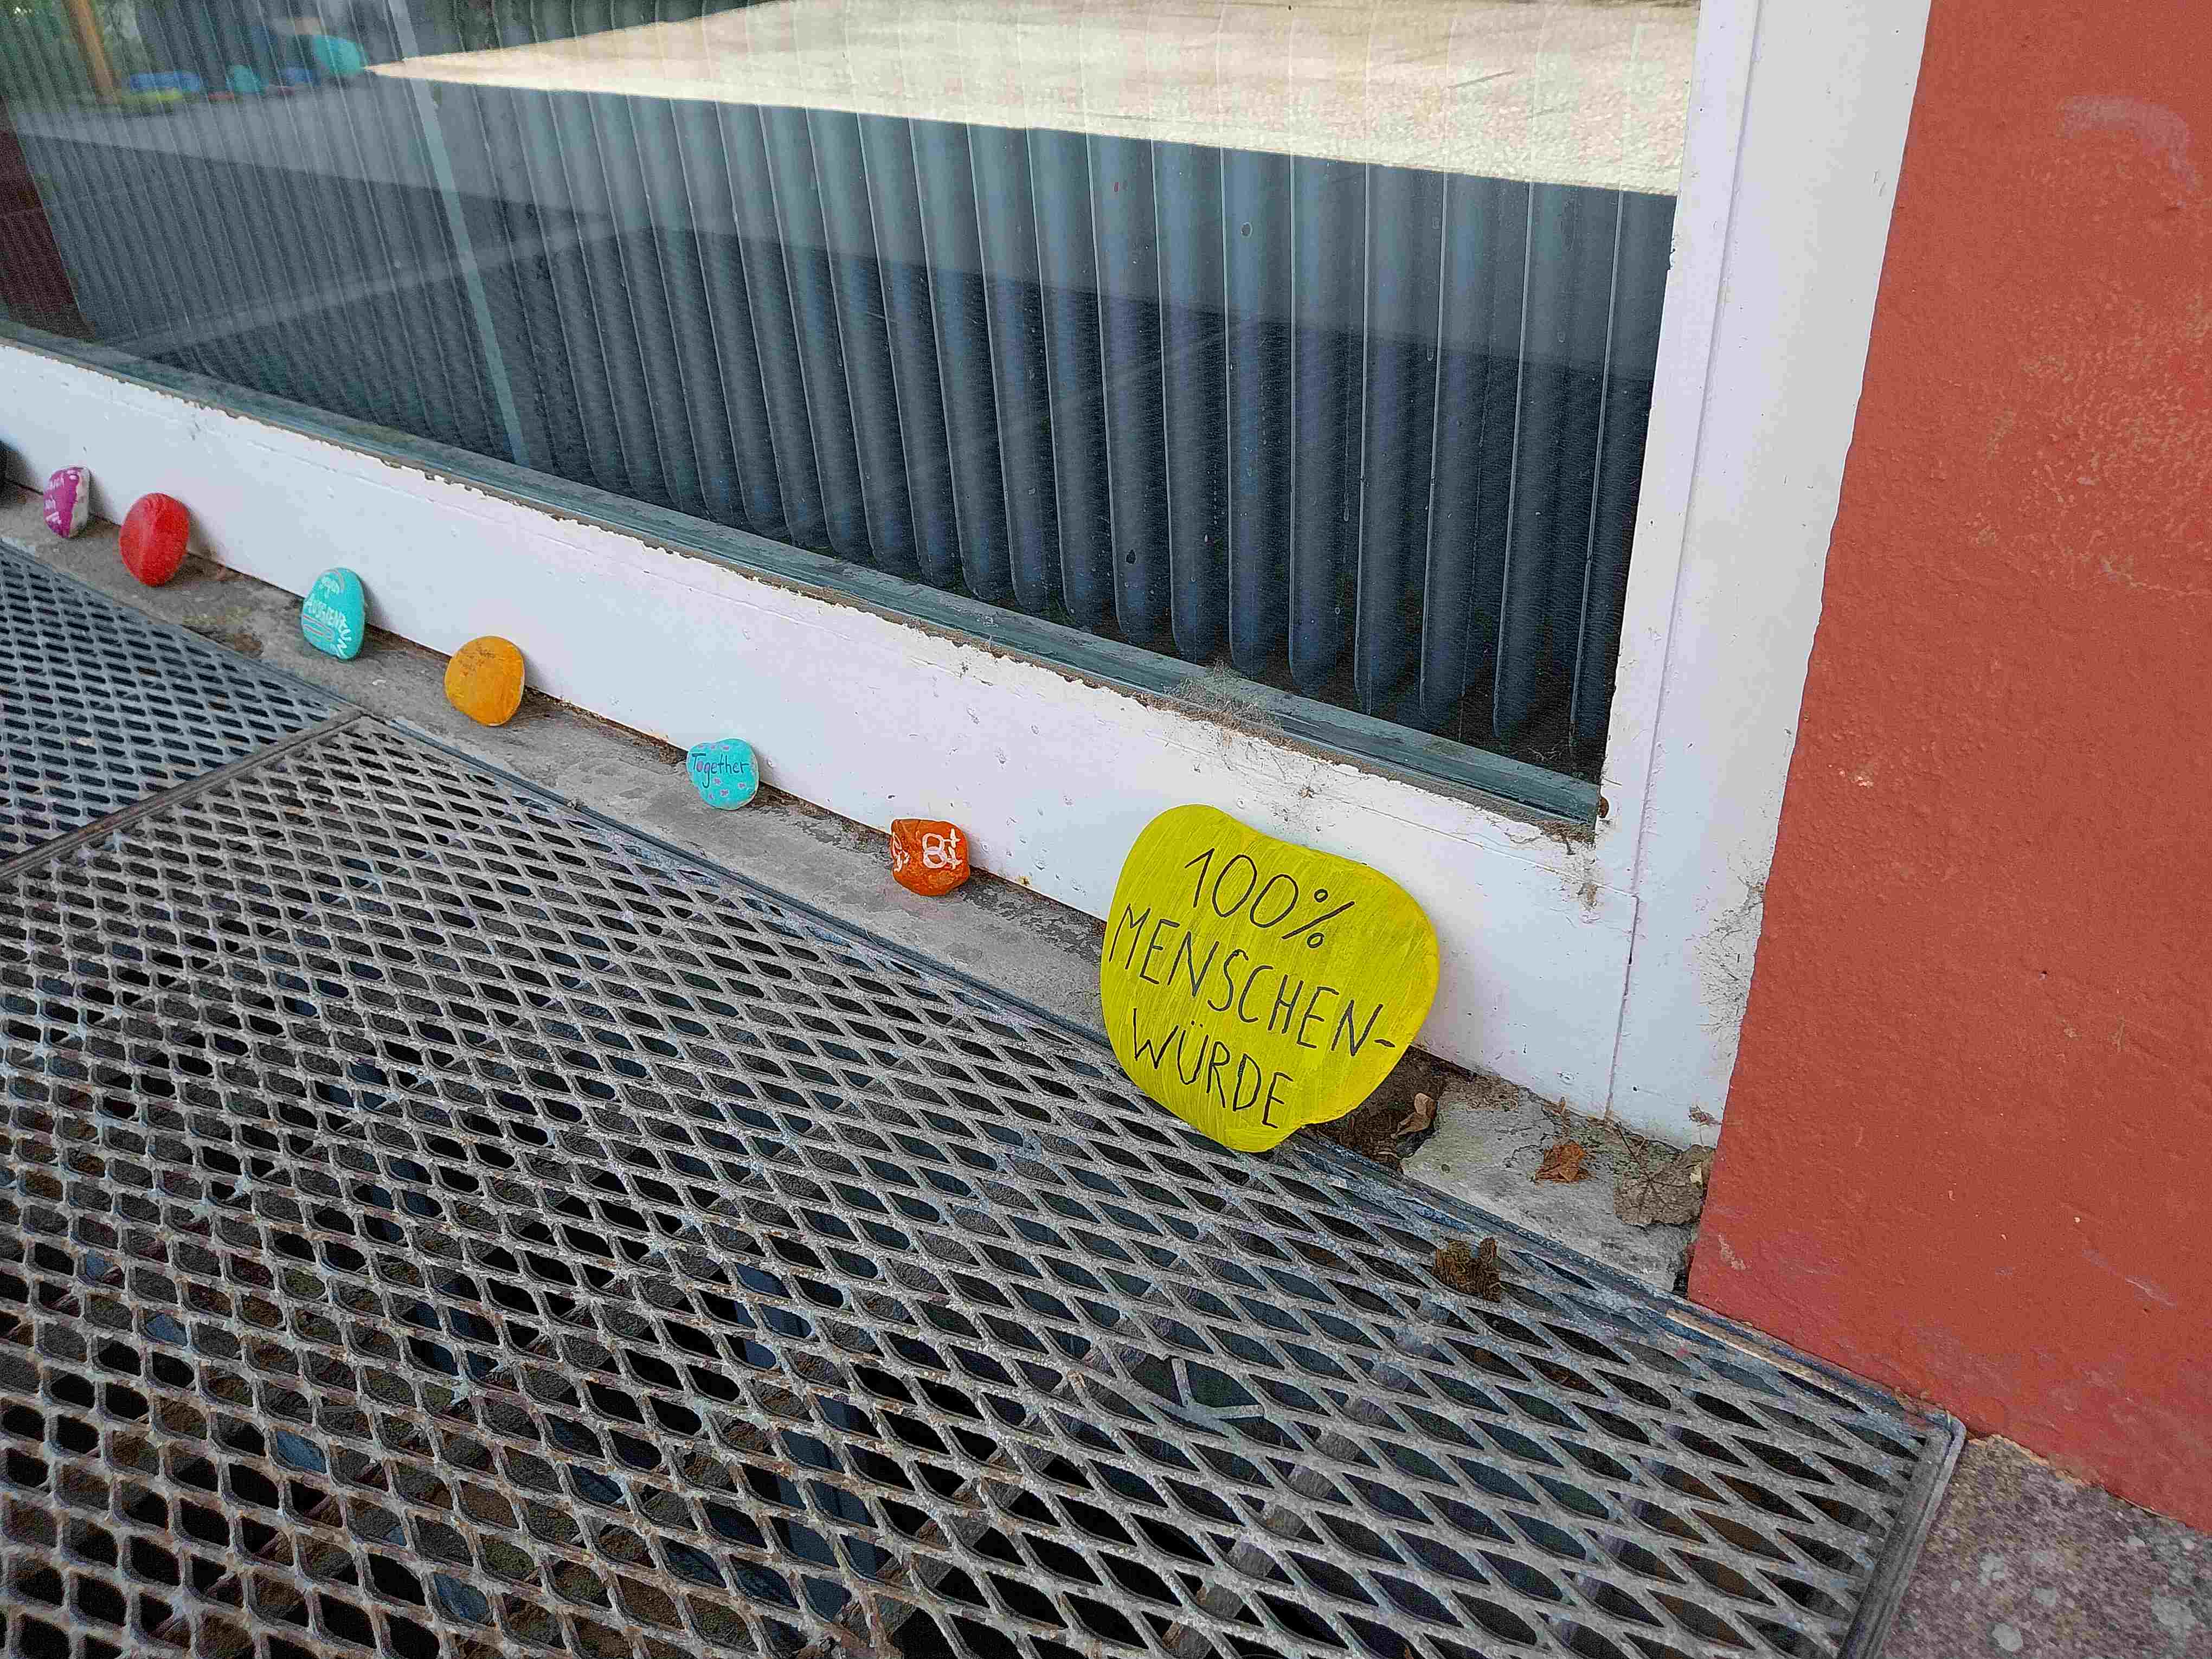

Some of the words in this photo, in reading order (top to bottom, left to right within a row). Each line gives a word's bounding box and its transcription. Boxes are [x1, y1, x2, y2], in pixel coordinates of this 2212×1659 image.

[691, 753, 750, 789] Together
[1185, 847, 1355, 949] 100%
[1108, 903, 1396, 1057] MENSCHEN-
[1132, 1007, 1294, 1129] WÜRDE
